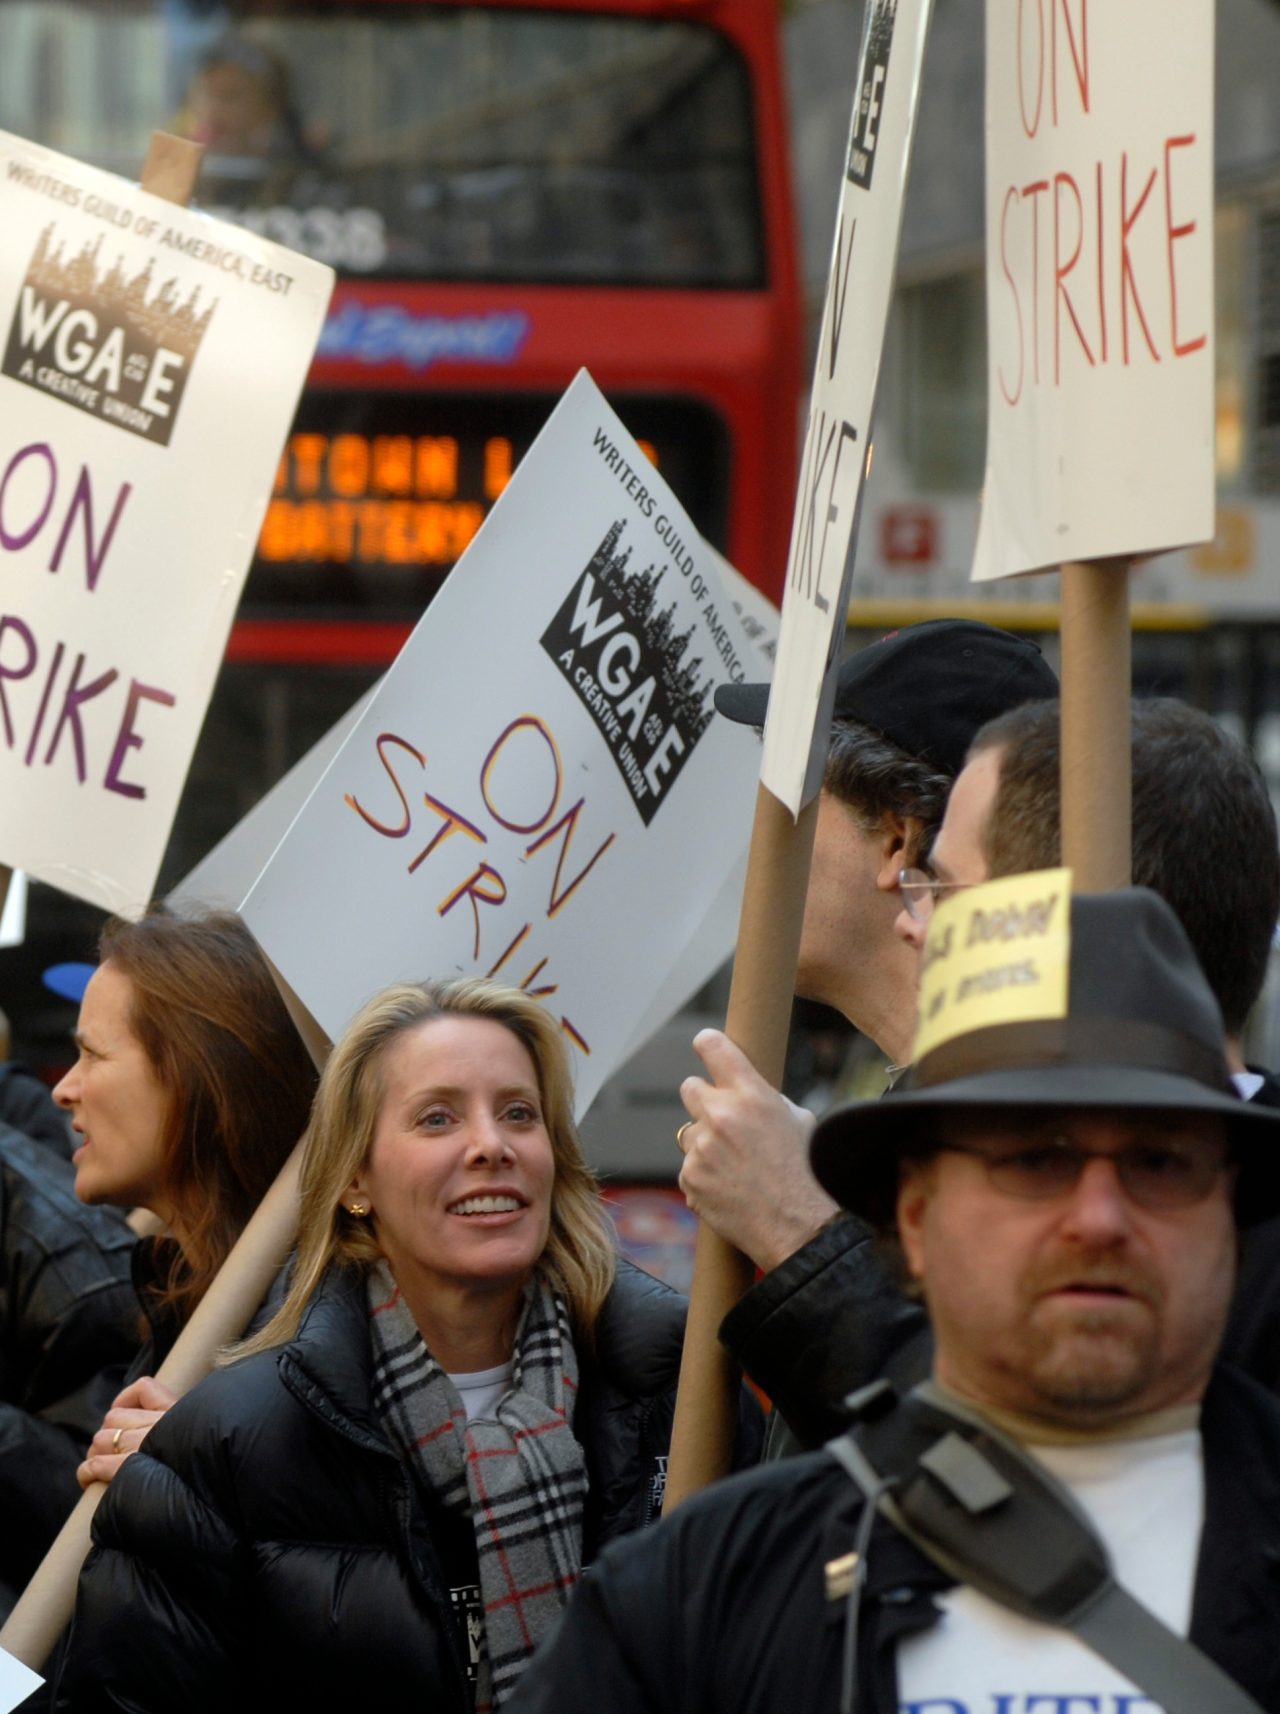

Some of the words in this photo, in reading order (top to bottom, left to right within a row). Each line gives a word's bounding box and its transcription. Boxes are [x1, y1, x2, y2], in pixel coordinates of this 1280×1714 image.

[1017, 0, 1089, 138] ON
[6, 160, 81, 207] WRITERS
[82, 194, 133, 229] GUILD
[135, 215, 160, 239] OF
[160, 228, 247, 280] AMERICA,
[251, 264, 294, 297] EAST
[997, 133, 1207, 406] STRIKE
[592, 427, 658, 518] WRITERS
[654, 515, 695, 577] GUILD
[690, 574, 710, 602] OF
[559, 649, 575, 670] A
[574, 667, 622, 743] CREATIVE
[619, 741, 648, 799] UNION
[344, 732, 591, 1056] STRI
[480, 713, 617, 918] ON
